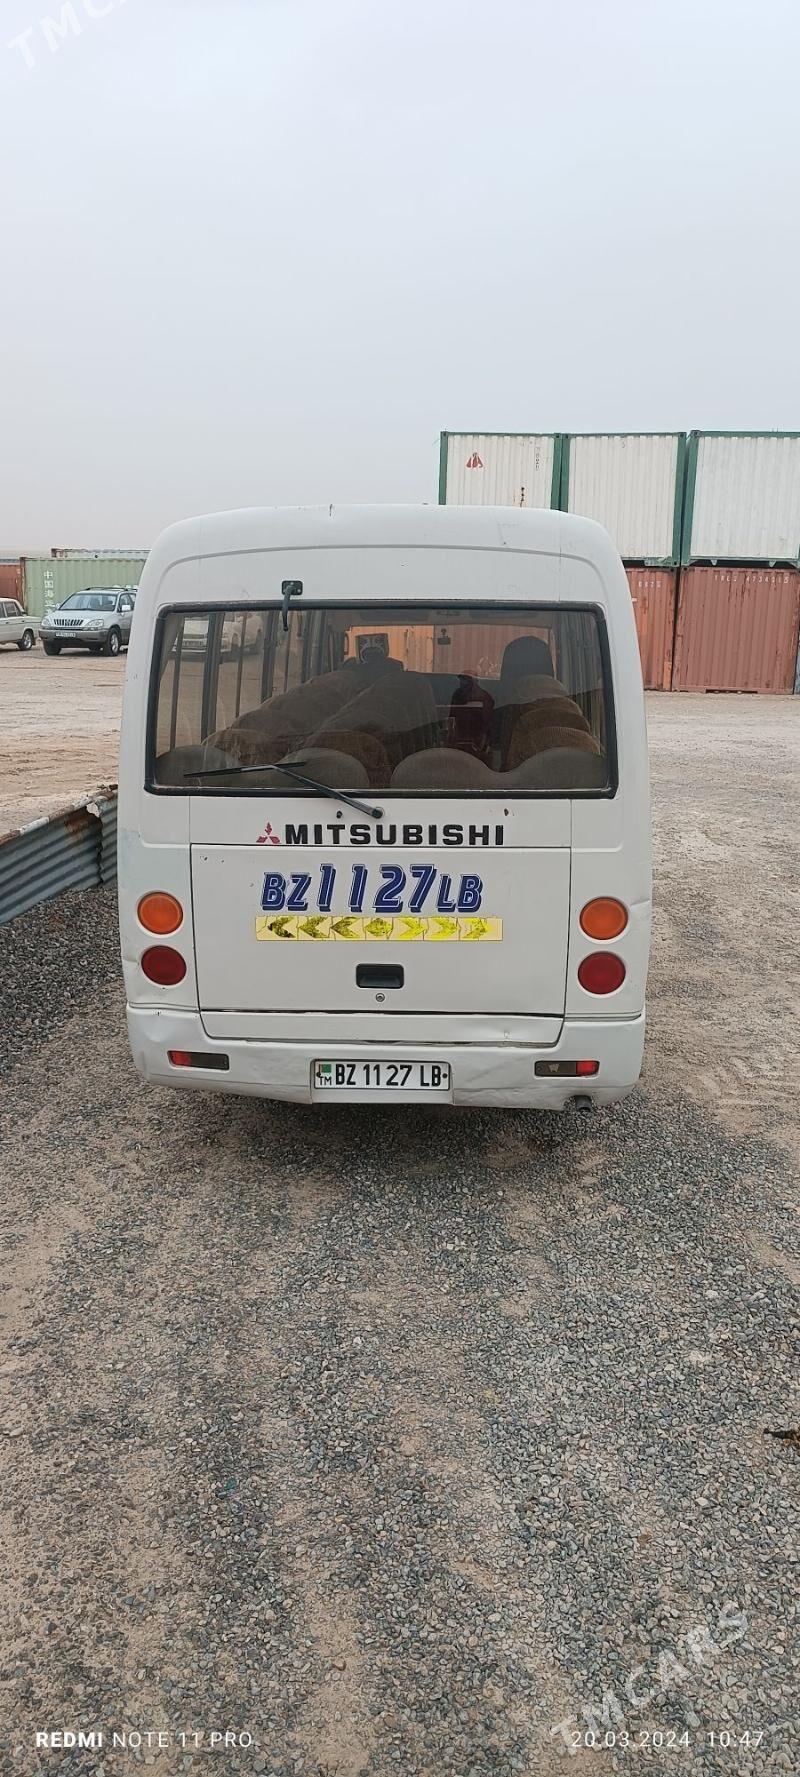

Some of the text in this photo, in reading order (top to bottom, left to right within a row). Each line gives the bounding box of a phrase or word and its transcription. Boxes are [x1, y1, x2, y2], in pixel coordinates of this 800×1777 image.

[285, 824, 504, 846] MITSUBISHI
[319, 1075, 332, 1086] TM
[335, 1063, 356, 1086] BZ
[420, 1065, 442, 1087] LB
